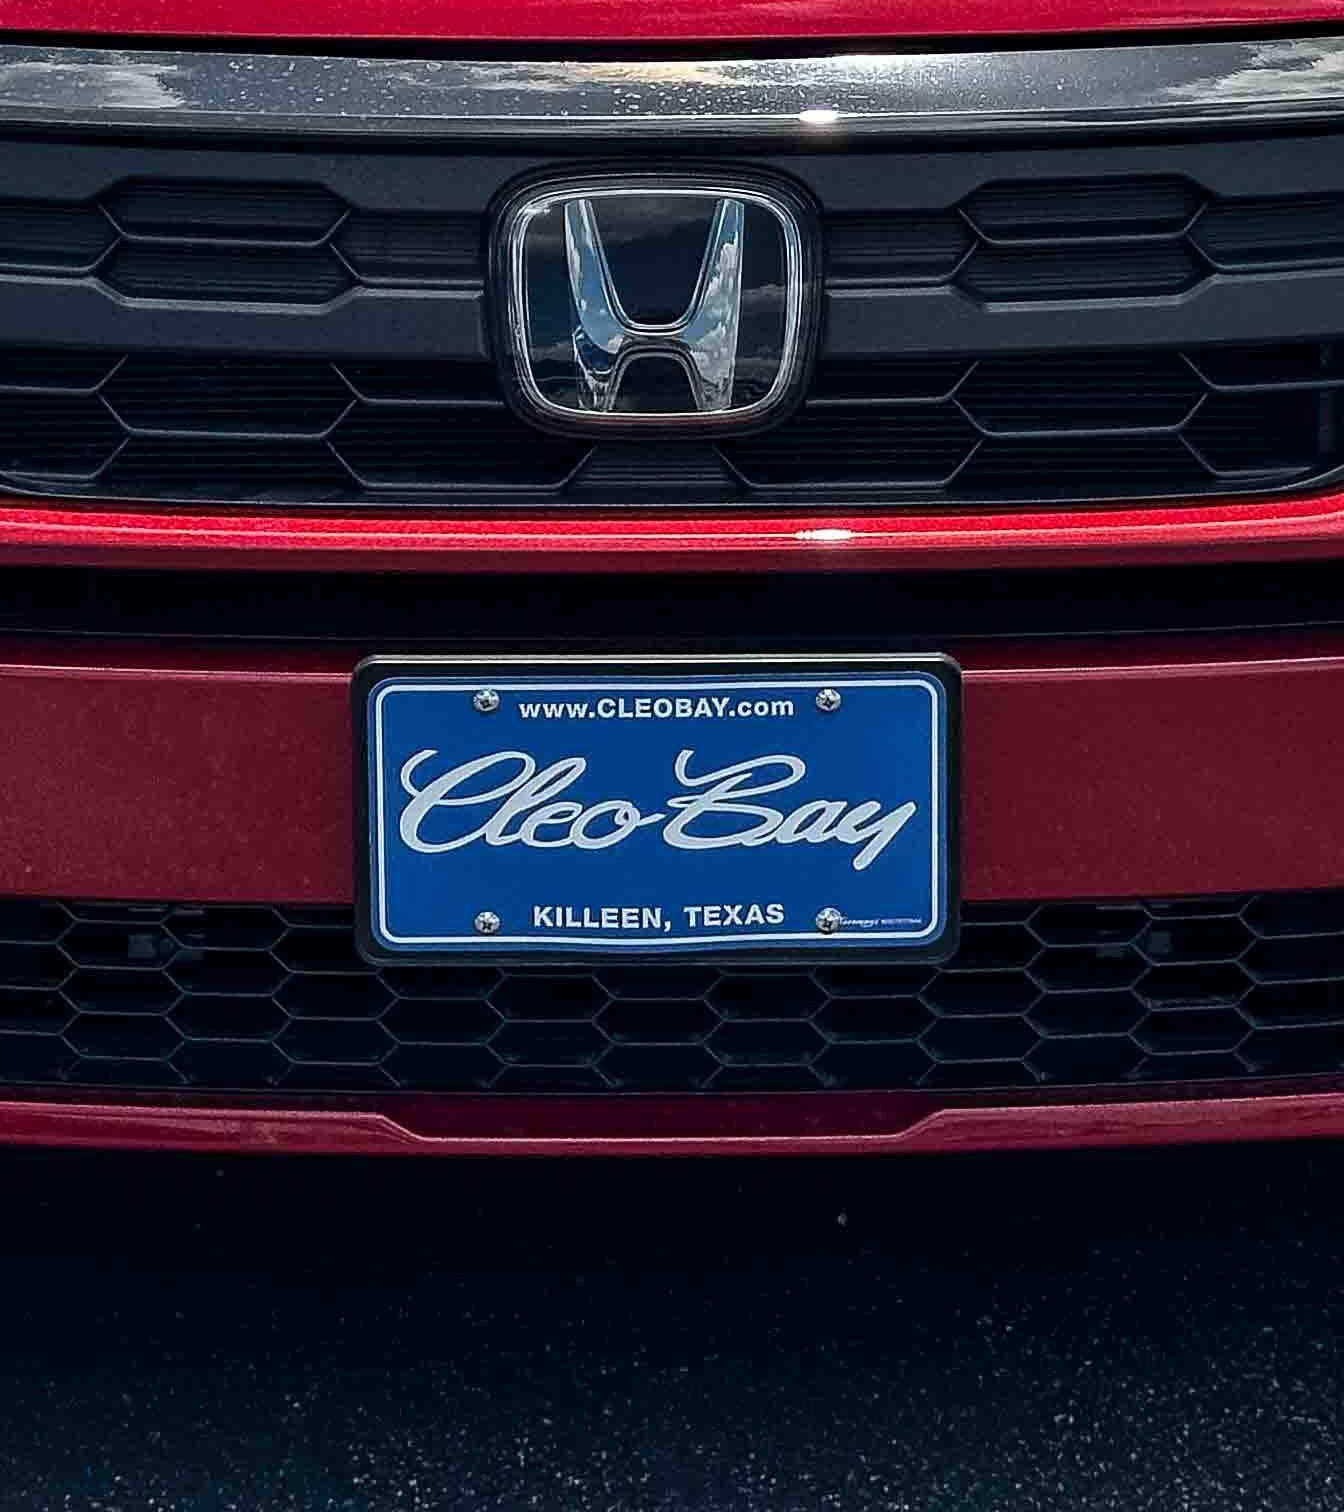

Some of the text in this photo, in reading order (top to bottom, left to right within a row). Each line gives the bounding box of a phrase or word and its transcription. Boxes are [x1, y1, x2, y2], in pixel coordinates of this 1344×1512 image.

[518, 697, 794, 719] www.CLEOBAY.com
[399, 749, 917, 870] Cleo Bay
[533, 903, 785, 932] KILLEEN, TEXAS
